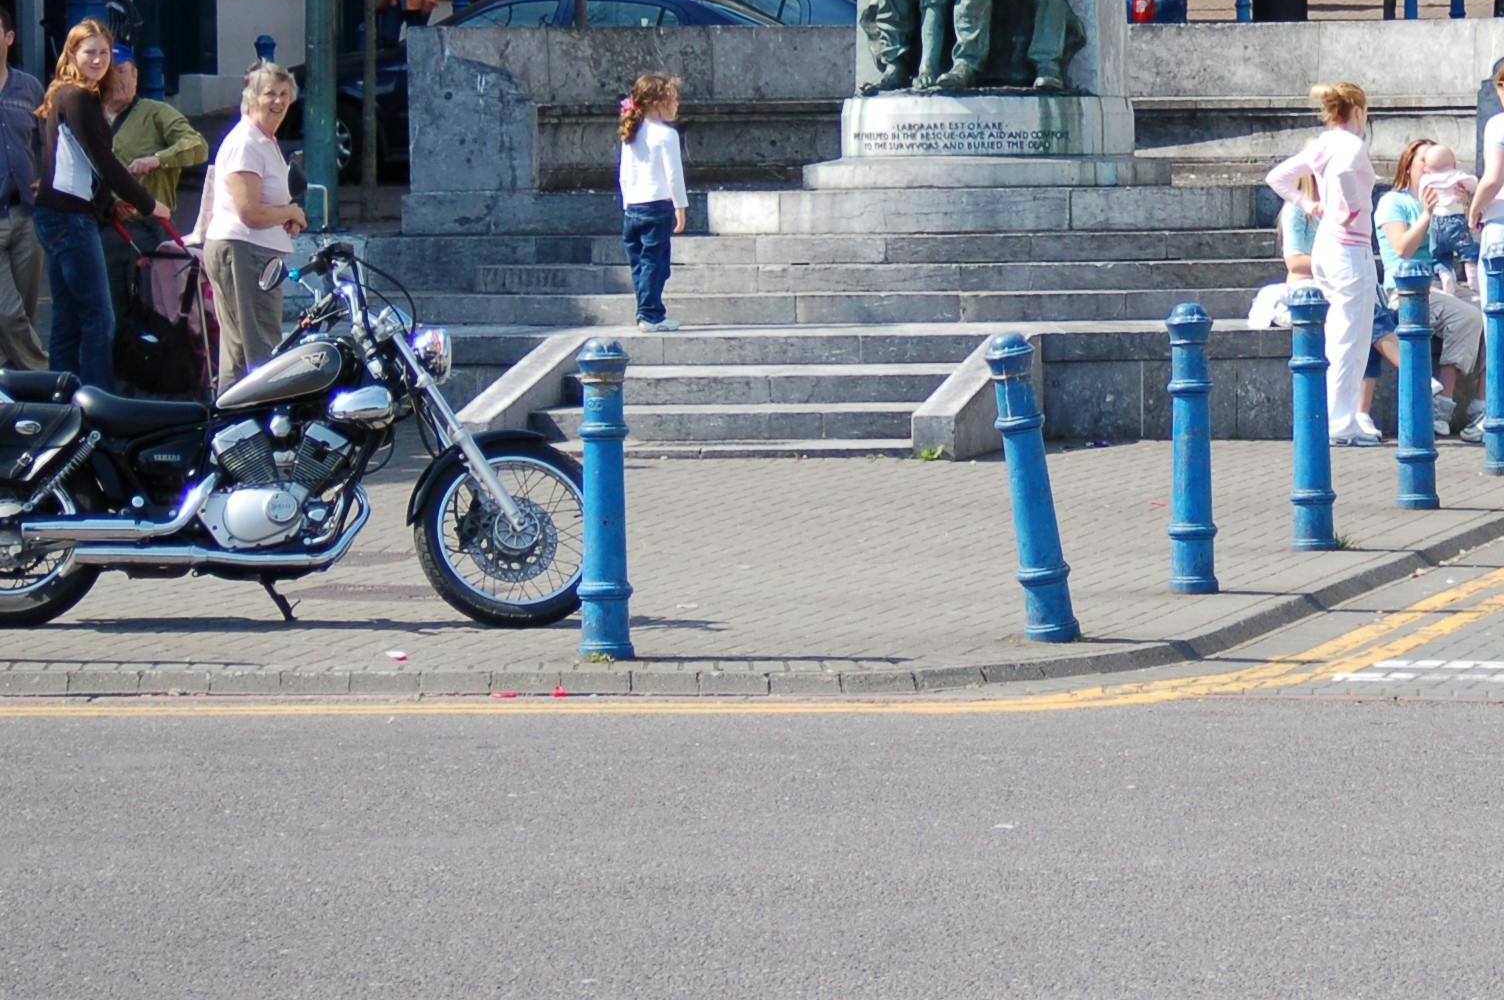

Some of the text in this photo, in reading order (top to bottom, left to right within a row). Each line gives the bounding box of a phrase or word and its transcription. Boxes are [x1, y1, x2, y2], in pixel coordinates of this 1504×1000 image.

[896, 121, 1003, 131] LABORARE EST ORARE
[903, 131, 918, 140] THE
[988, 131, 1006, 139] AID
[1008, 131, 1029, 139] AND
[942, 141, 965, 150] AND
[967, 140, 1003, 150] BURIED
[1007, 140, 1025, 149] THE
